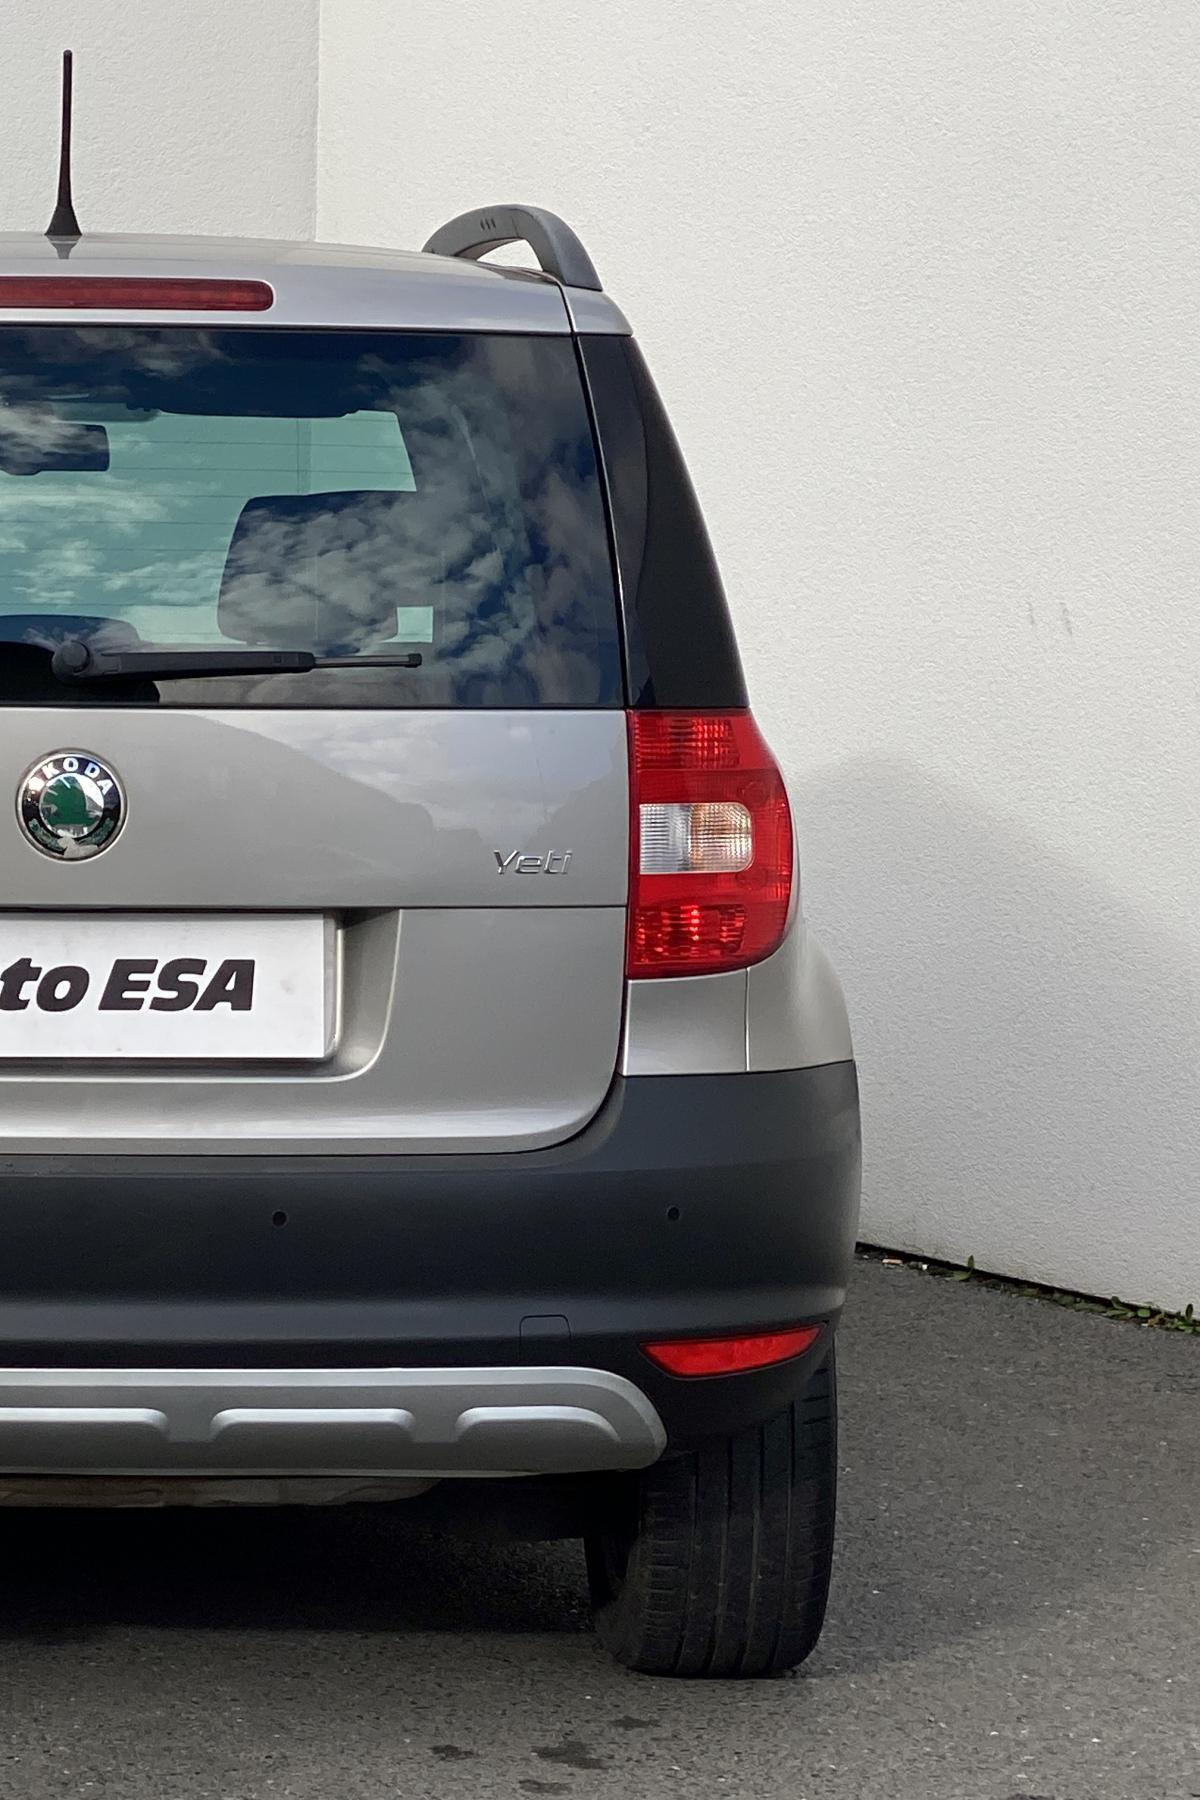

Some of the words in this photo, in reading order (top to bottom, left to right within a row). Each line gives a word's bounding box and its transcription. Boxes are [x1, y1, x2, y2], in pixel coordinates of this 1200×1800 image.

[27, 756, 114, 797] KODA
[493, 849, 573, 875] Yeti
[98, 958, 256, 1011] ESA
